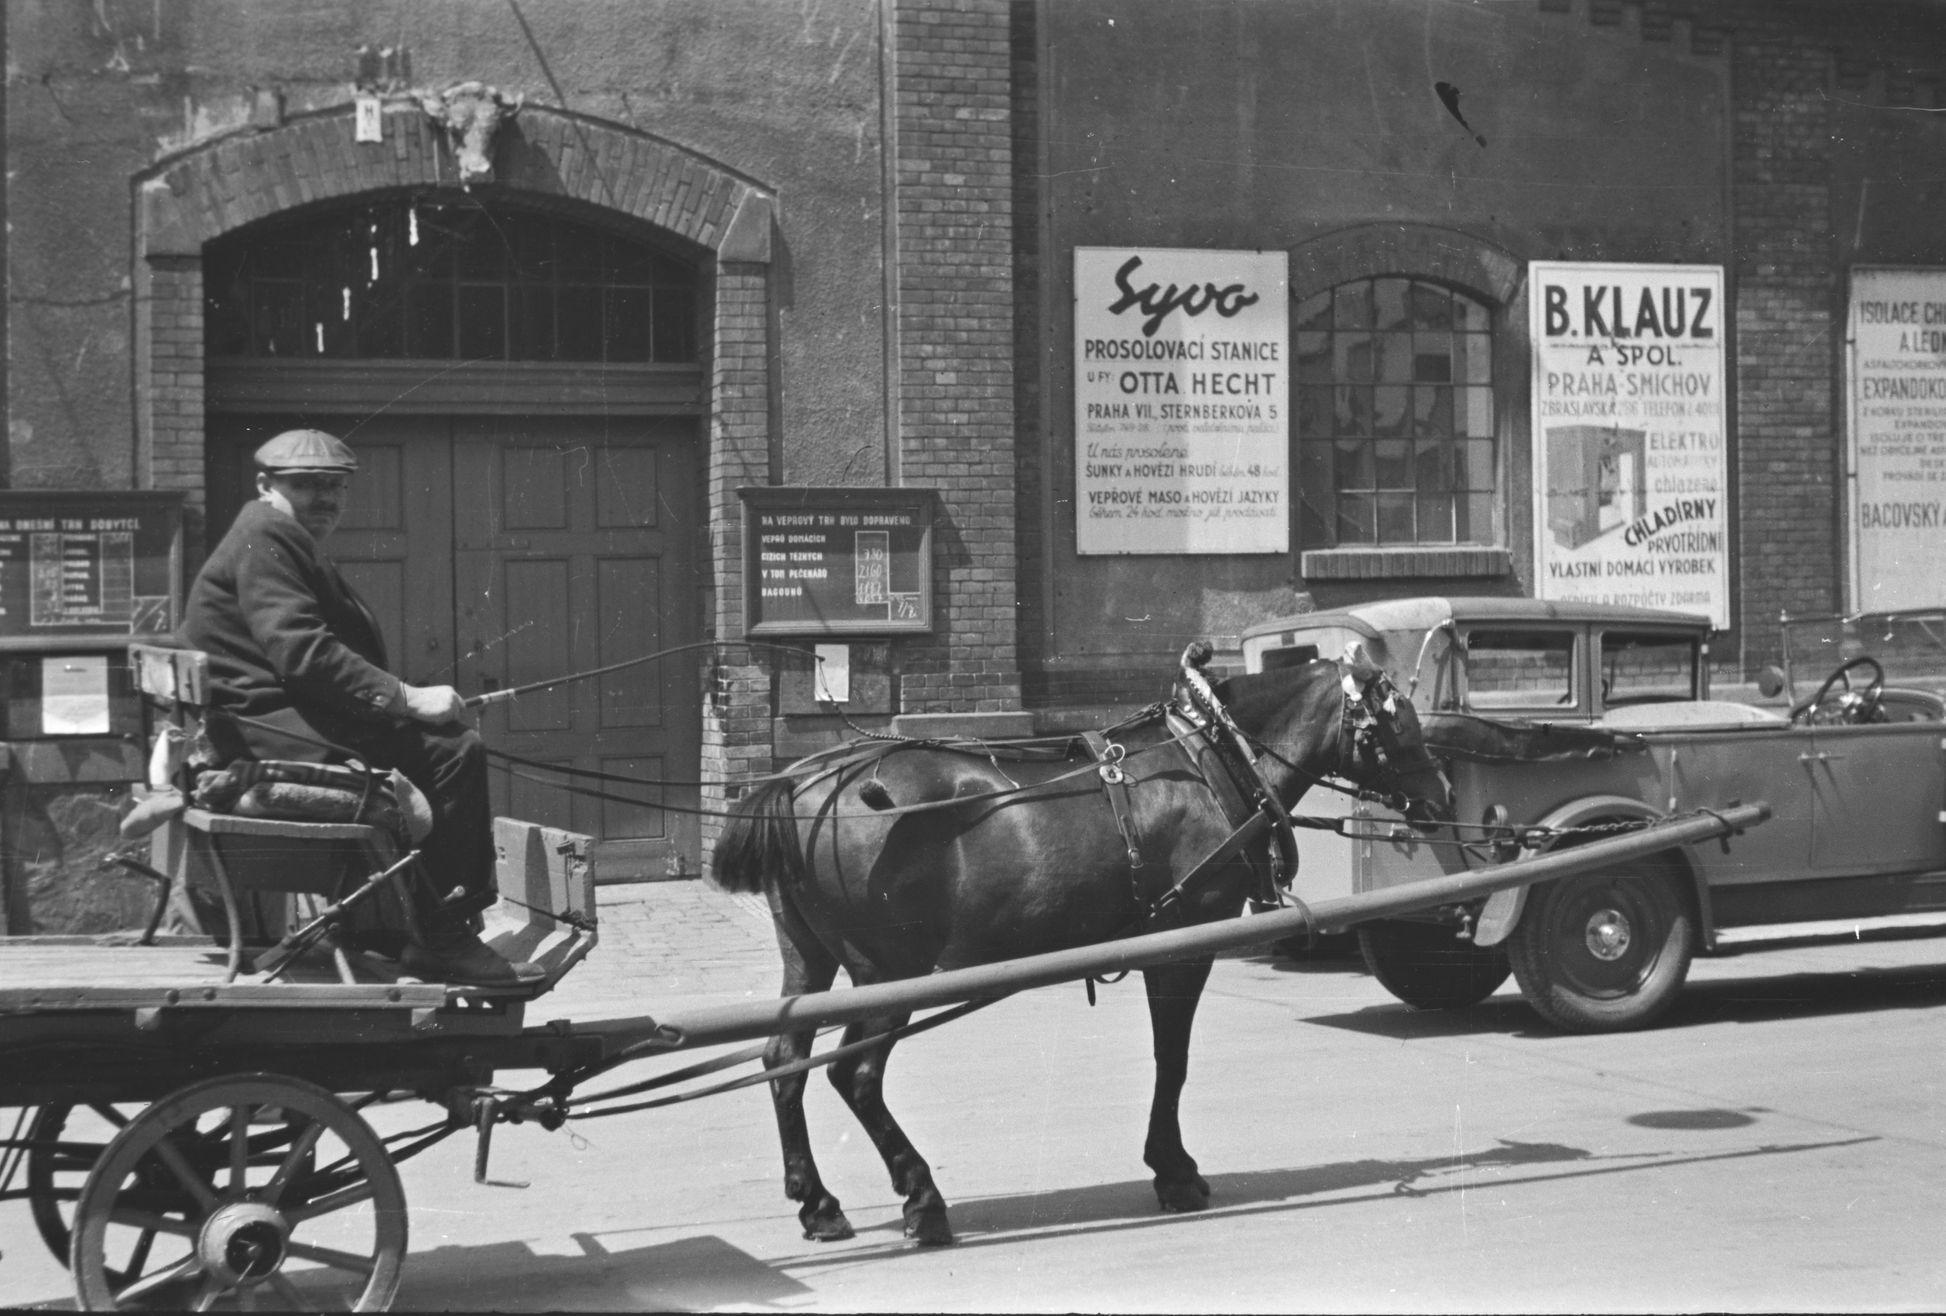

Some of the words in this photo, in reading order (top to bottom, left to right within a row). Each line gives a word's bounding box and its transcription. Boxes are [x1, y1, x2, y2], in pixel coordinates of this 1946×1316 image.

[1860, 301, 1919, 324] ISOLACE
[1084, 334, 1205, 361] PROSOLOVACÍ
[1211, 341, 1280, 361] STANICE
[1586, 346, 1606, 367] A
[1617, 345, 1683, 367] SPOL.
[1120, 371, 1180, 395] OTTA
[1192, 372, 1277, 396] HECHT
[1087, 403, 1131, 420] PRAHA
[1268, 404, 1279, 420] 5
[1148, 490, 1183, 505] MASO
[1238, 490, 1280, 505] JAZYKY
[1624, 498, 1716, 547] CHLADÍRNY
